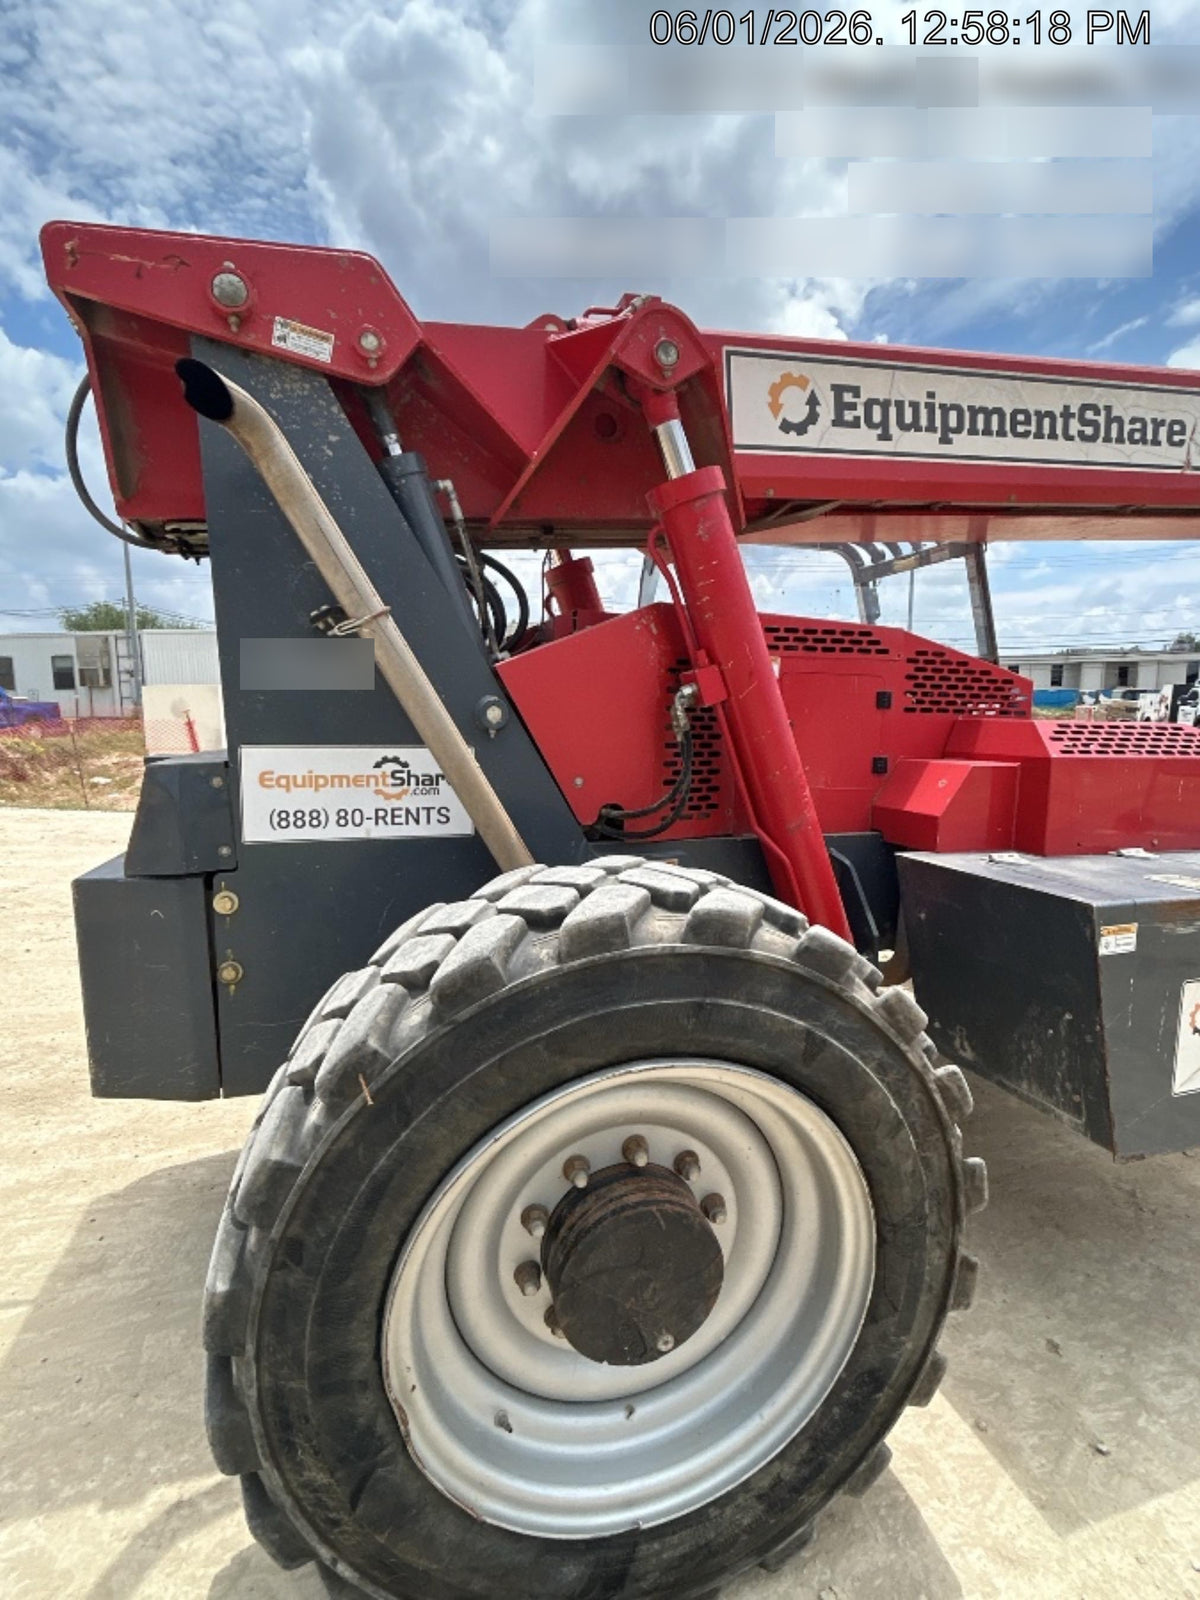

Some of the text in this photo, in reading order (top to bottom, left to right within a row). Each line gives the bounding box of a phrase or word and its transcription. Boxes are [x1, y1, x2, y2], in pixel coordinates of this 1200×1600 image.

[830, 383, 1187, 447] EquipmentShare
[258, 769, 451, 793] EquipmentShar
[410, 787, 440, 796] .com
[269, 806, 450, 831] (888) 80-RENTS
